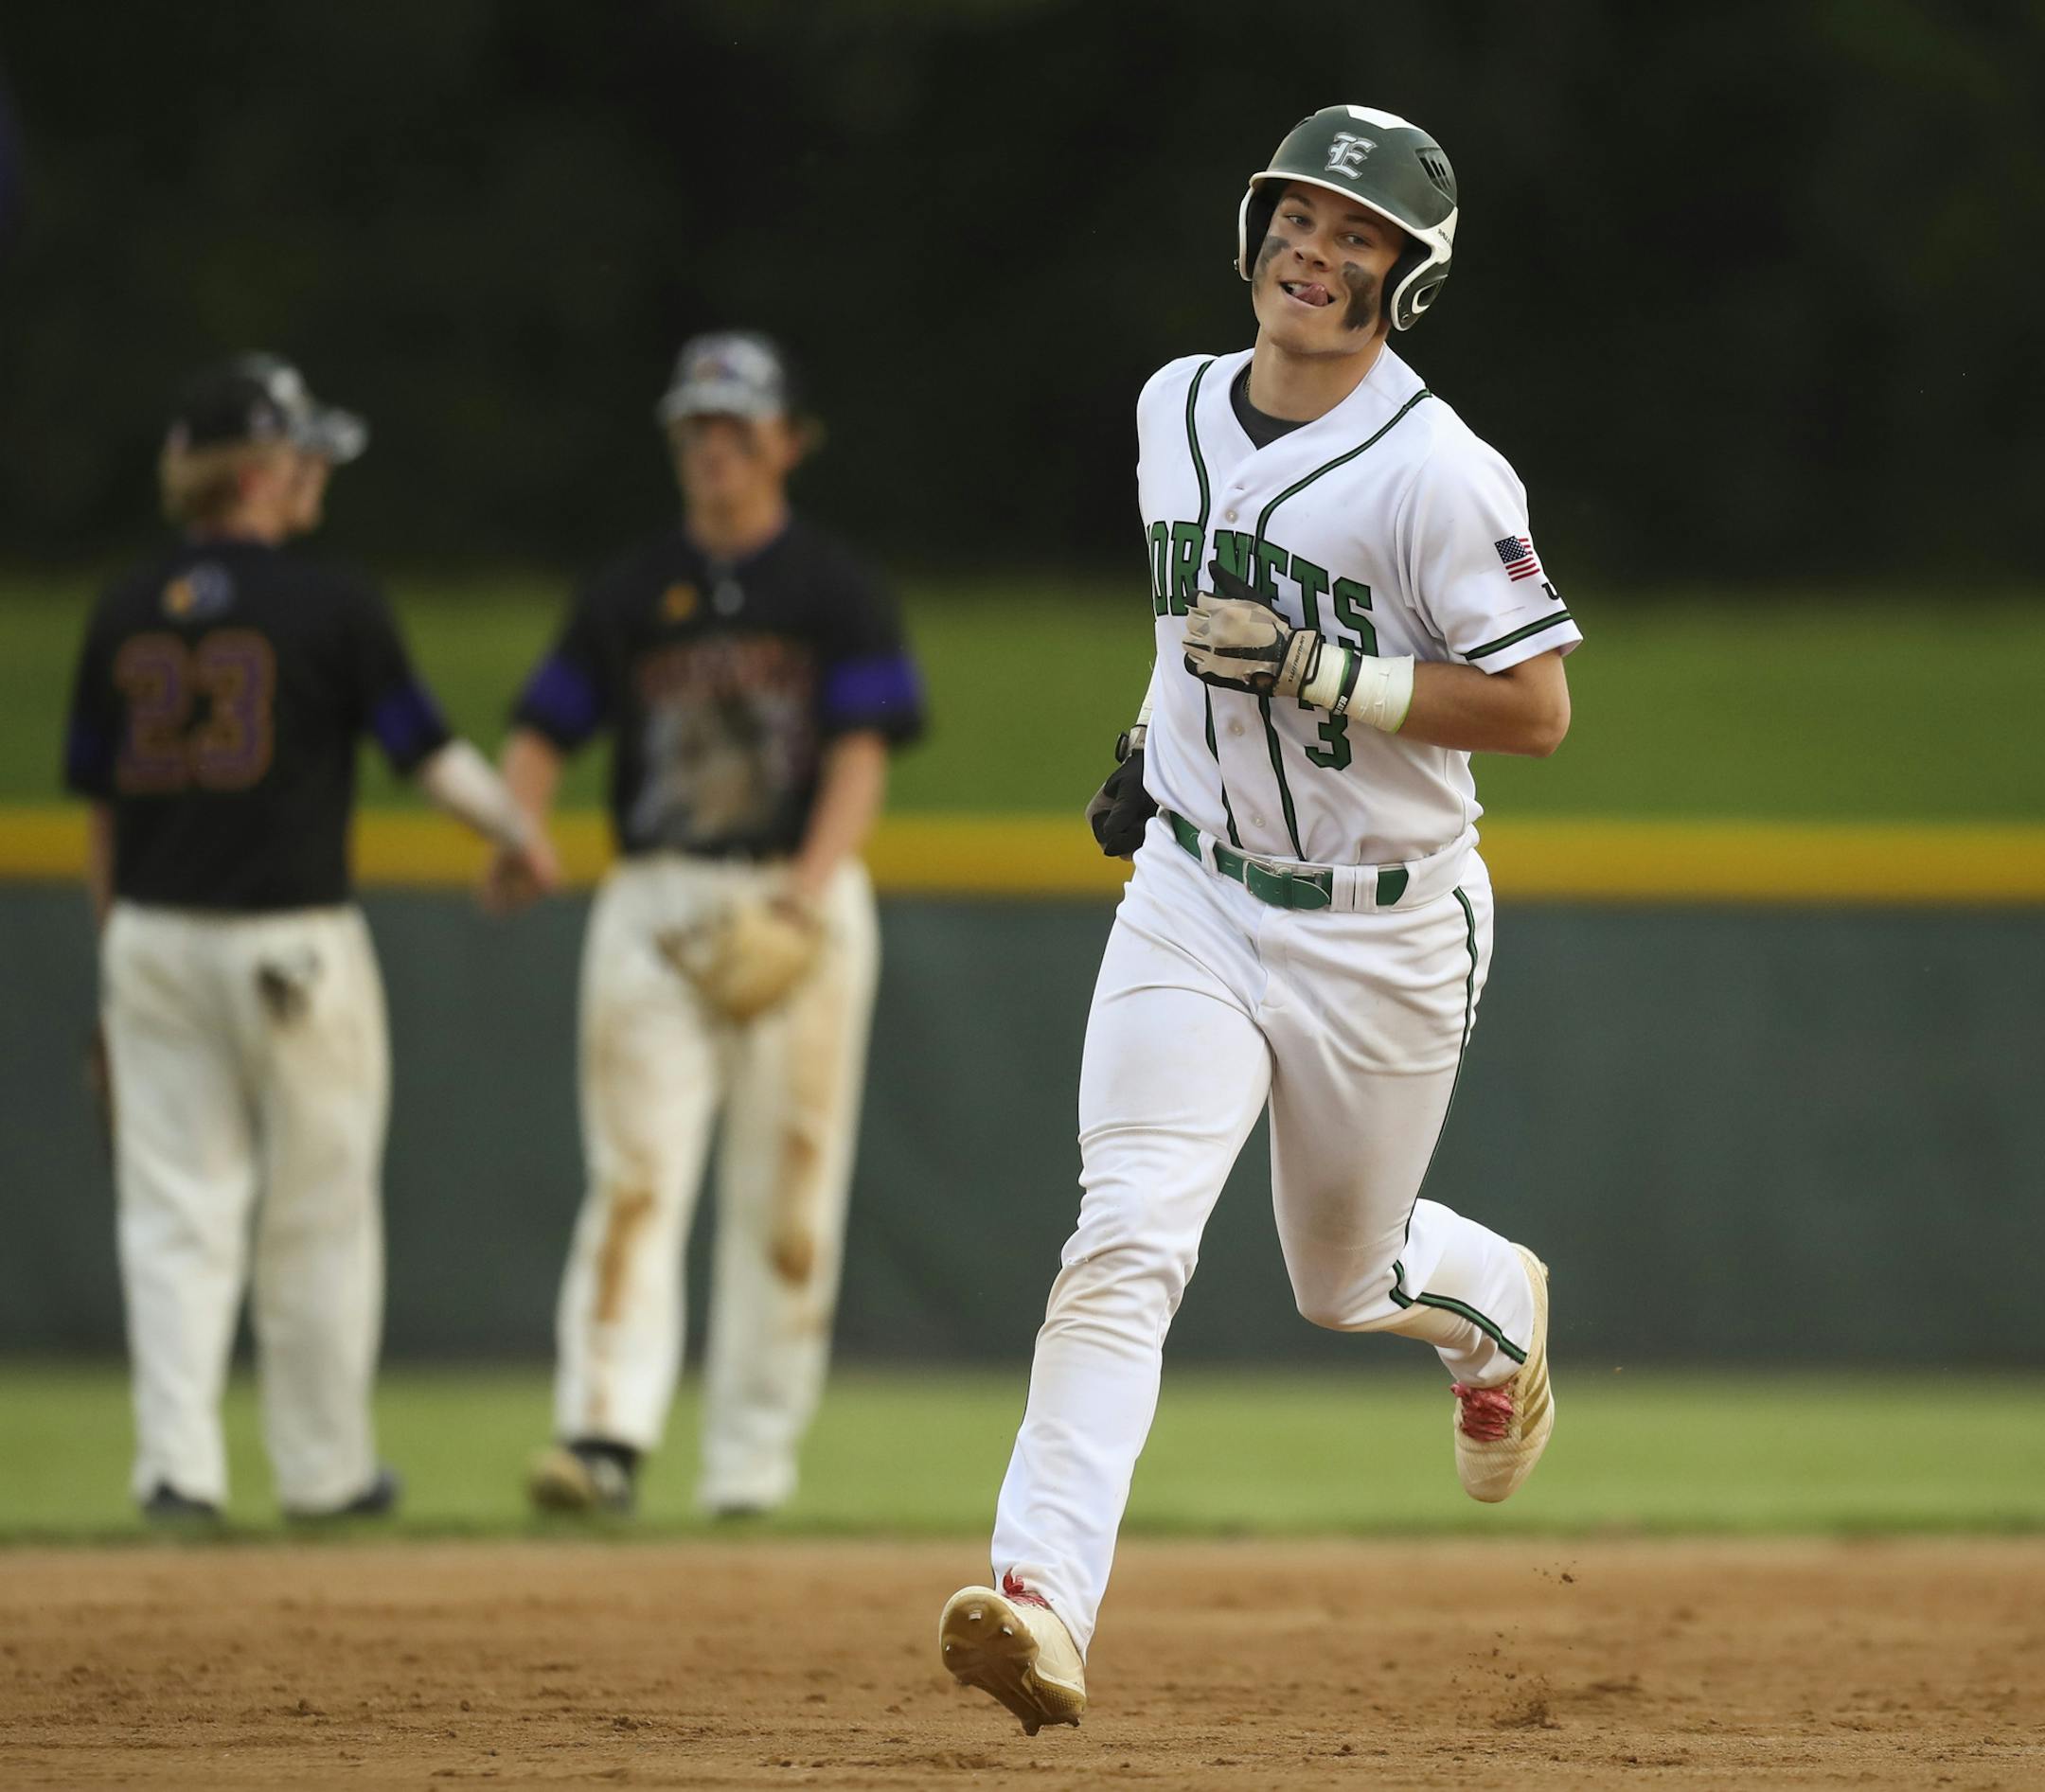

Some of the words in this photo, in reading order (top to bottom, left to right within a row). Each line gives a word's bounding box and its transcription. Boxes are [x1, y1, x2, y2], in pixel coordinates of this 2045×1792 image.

[1325, 132, 1377, 180] E
[1147, 521, 1379, 658] ORNETS
[114, 629, 276, 792] 23
[1298, 699, 1352, 771] 3
